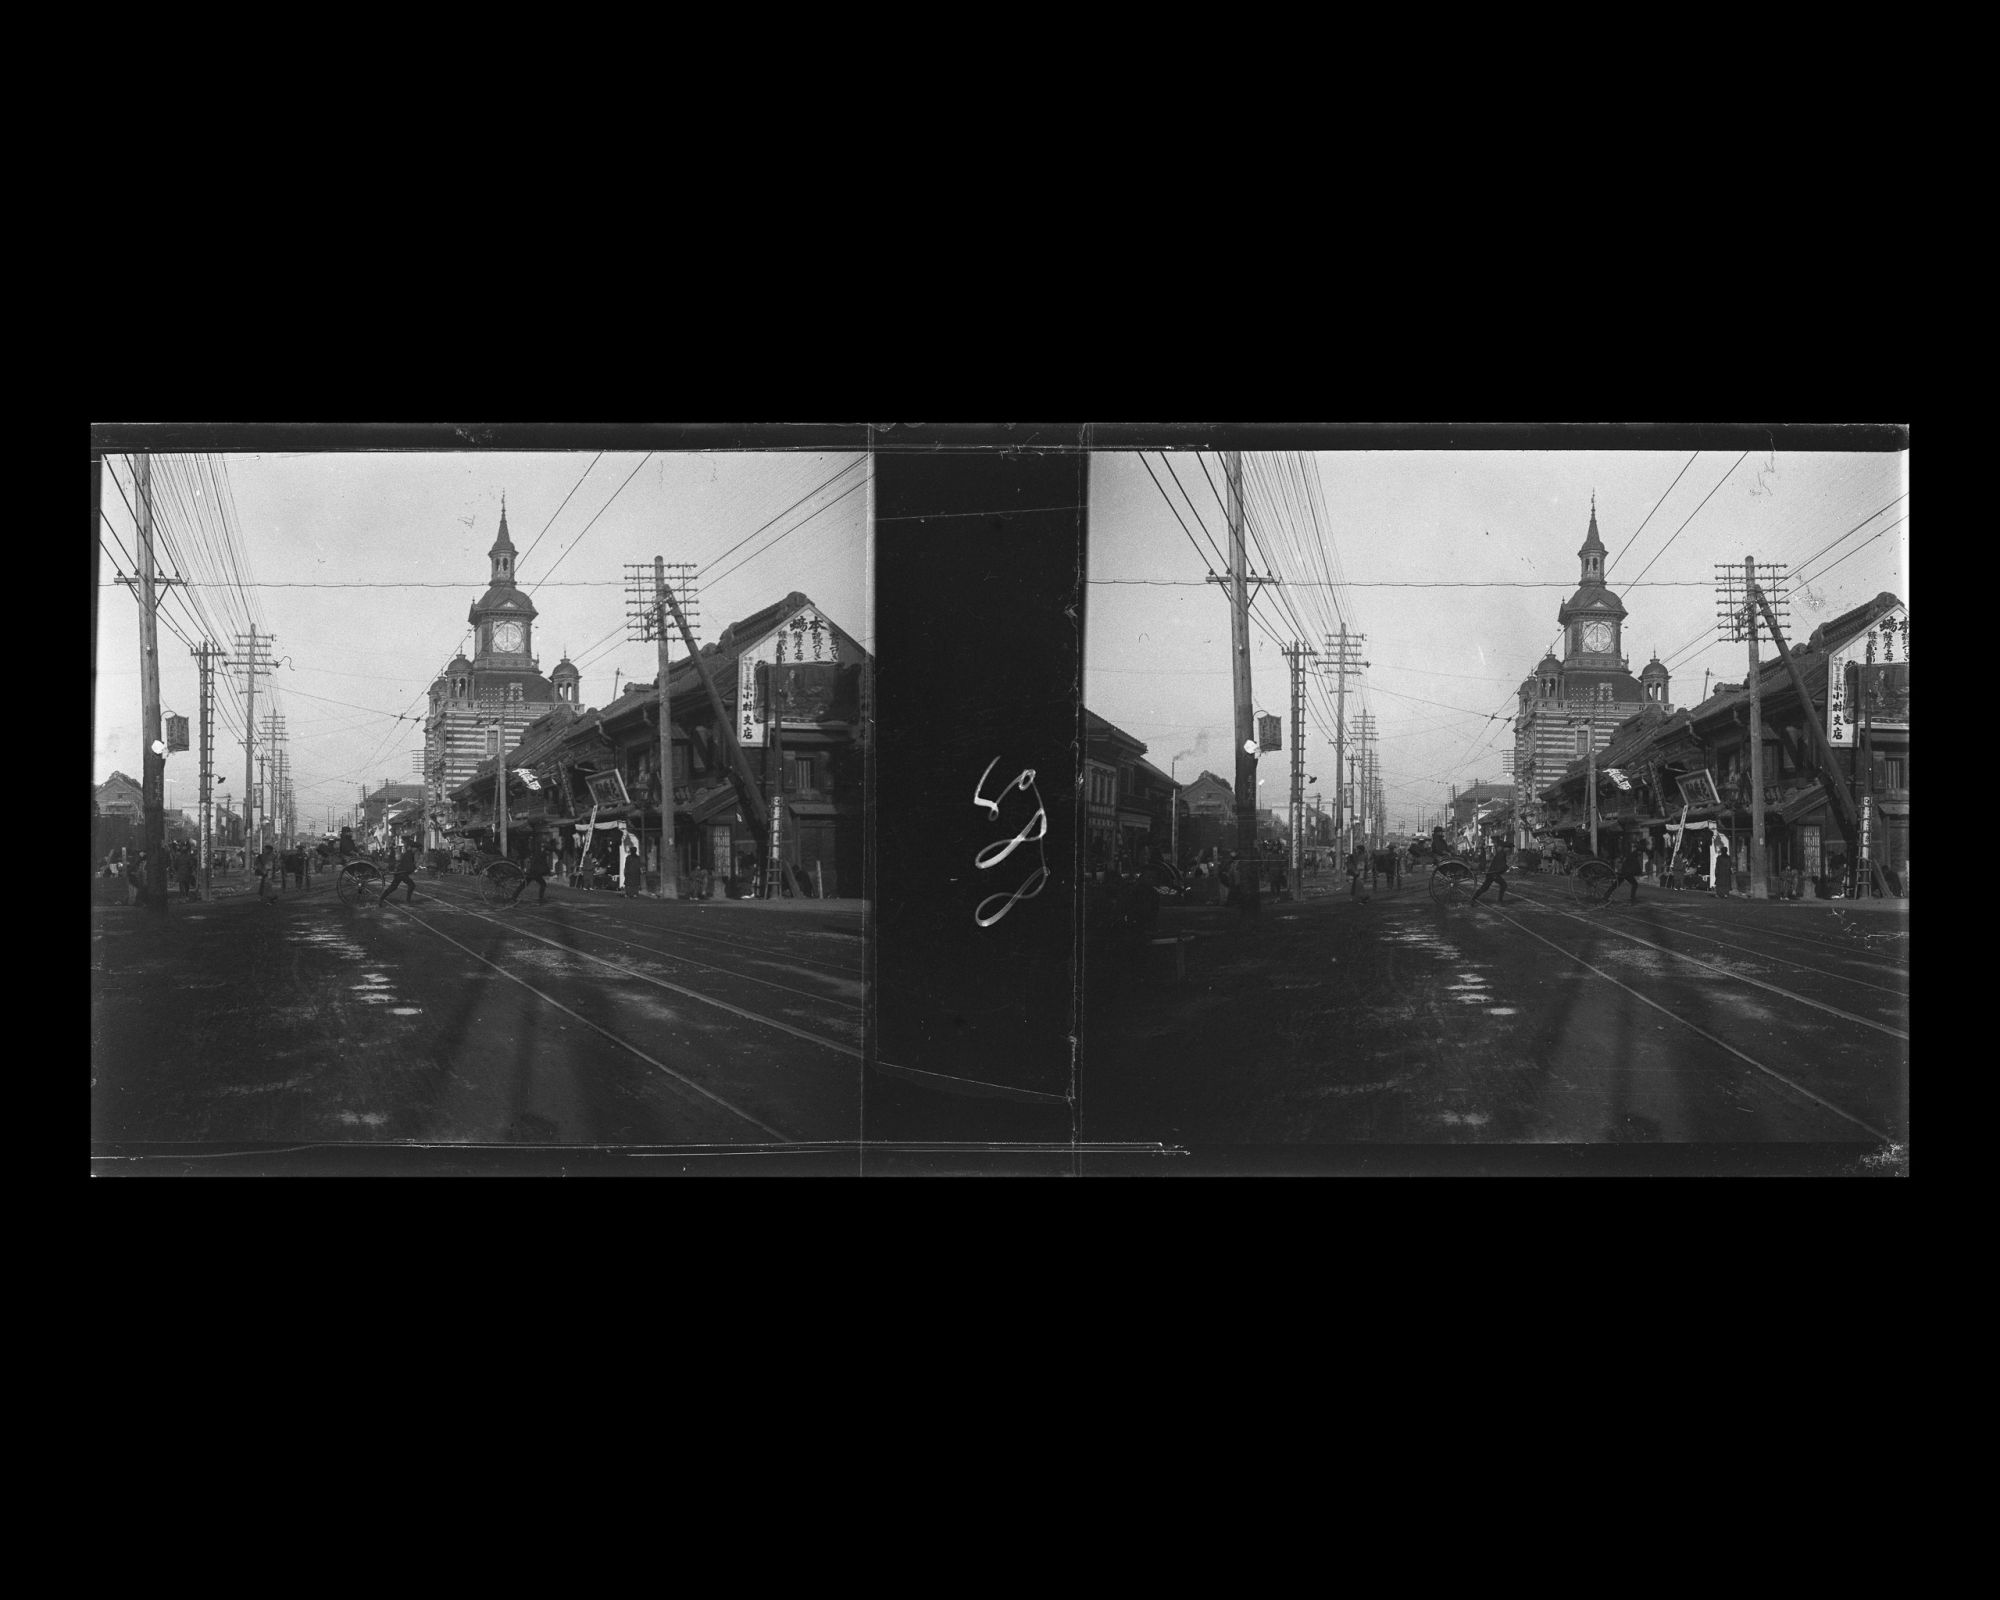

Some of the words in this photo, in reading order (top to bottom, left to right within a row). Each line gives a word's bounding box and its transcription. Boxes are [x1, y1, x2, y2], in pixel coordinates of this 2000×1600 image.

[742, 692, 754, 740] 小村支店
[1832, 692, 1844, 740] 小村支店
